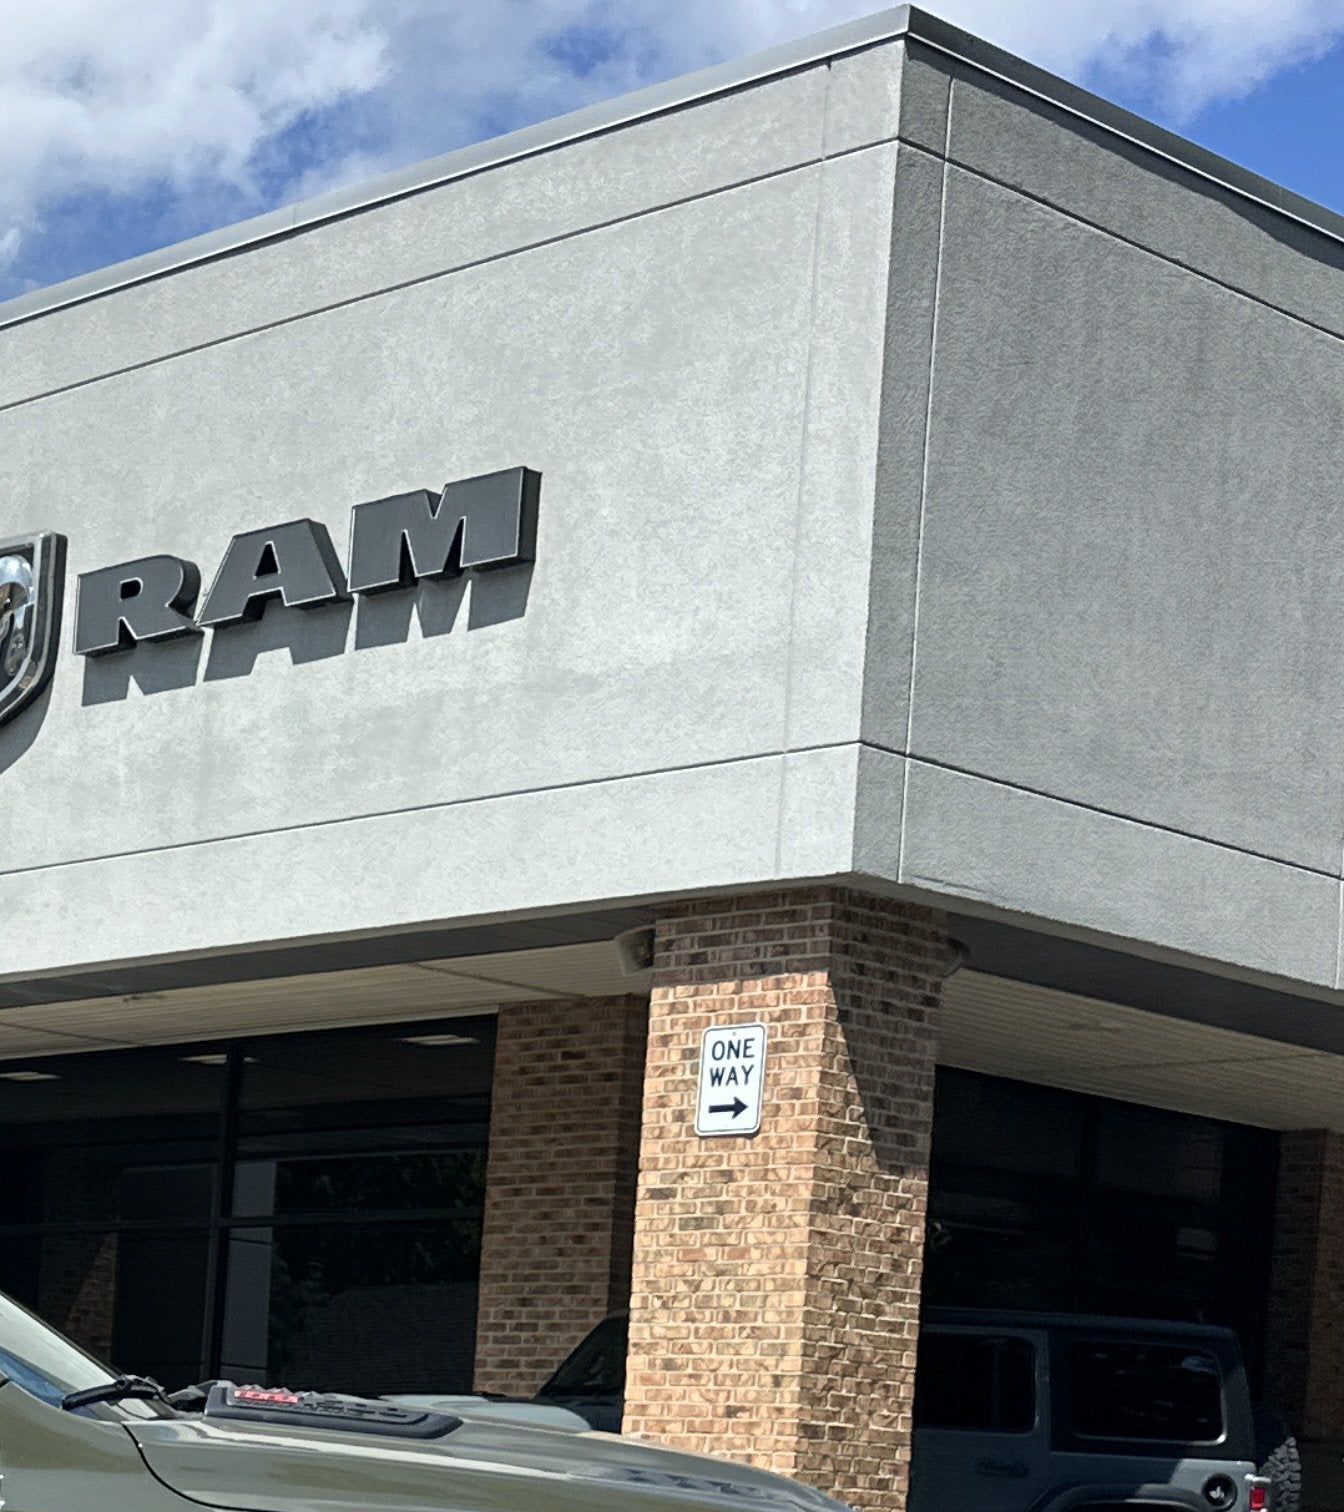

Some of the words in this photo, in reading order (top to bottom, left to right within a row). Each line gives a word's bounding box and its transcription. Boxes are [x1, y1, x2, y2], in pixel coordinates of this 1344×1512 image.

[73, 466, 542, 656] RAM
[711, 1038, 755, 1061] ONE
[709, 1064, 754, 1088] WAY
